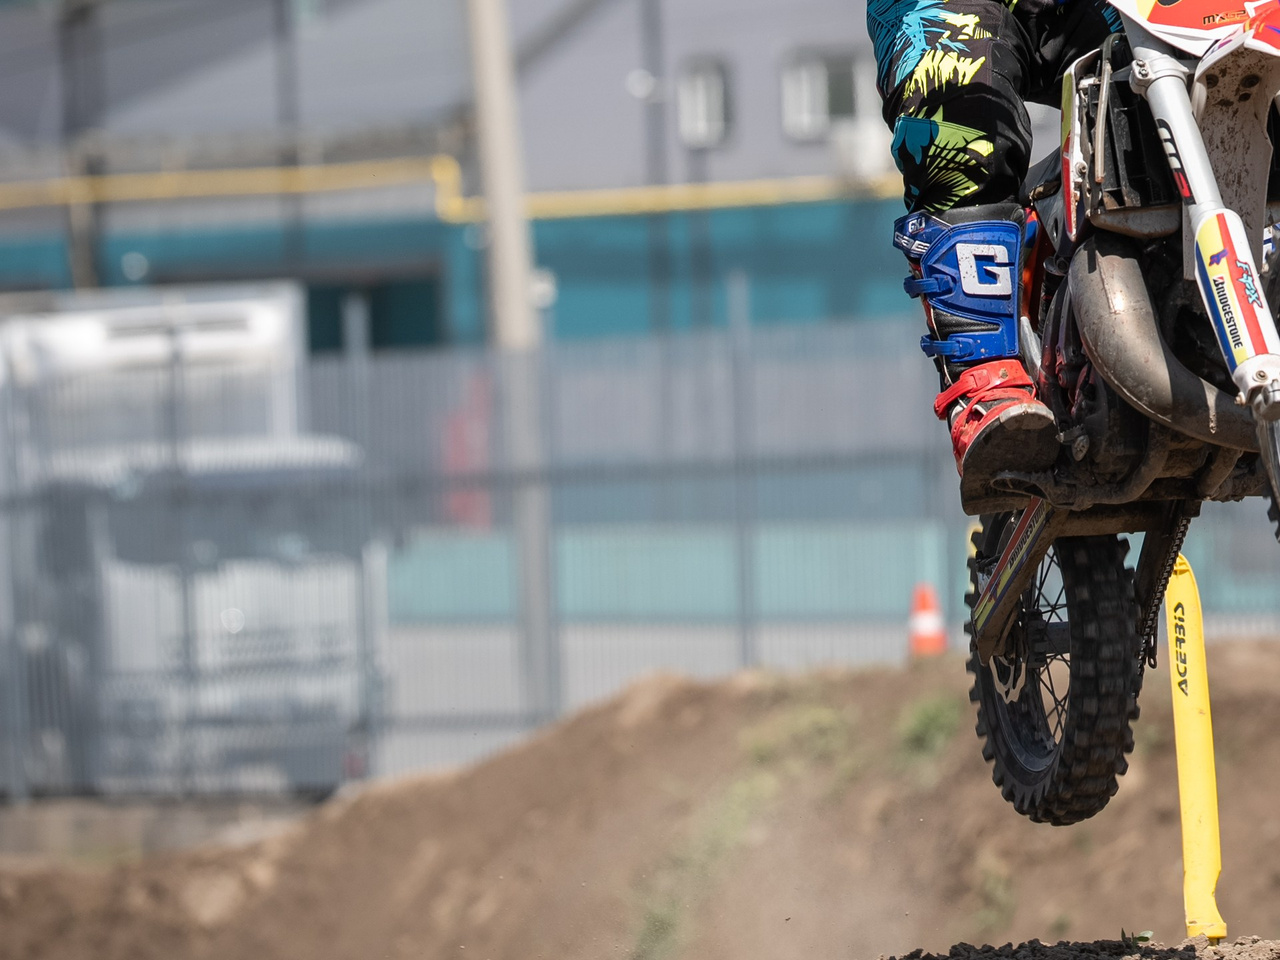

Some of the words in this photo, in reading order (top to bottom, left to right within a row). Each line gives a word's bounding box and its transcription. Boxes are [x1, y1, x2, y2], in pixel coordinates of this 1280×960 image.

[955, 243, 1012, 296] G
[1212, 275, 1244, 349] BRIDGESTONE
[1173, 601, 1189, 697] ACERBIS
